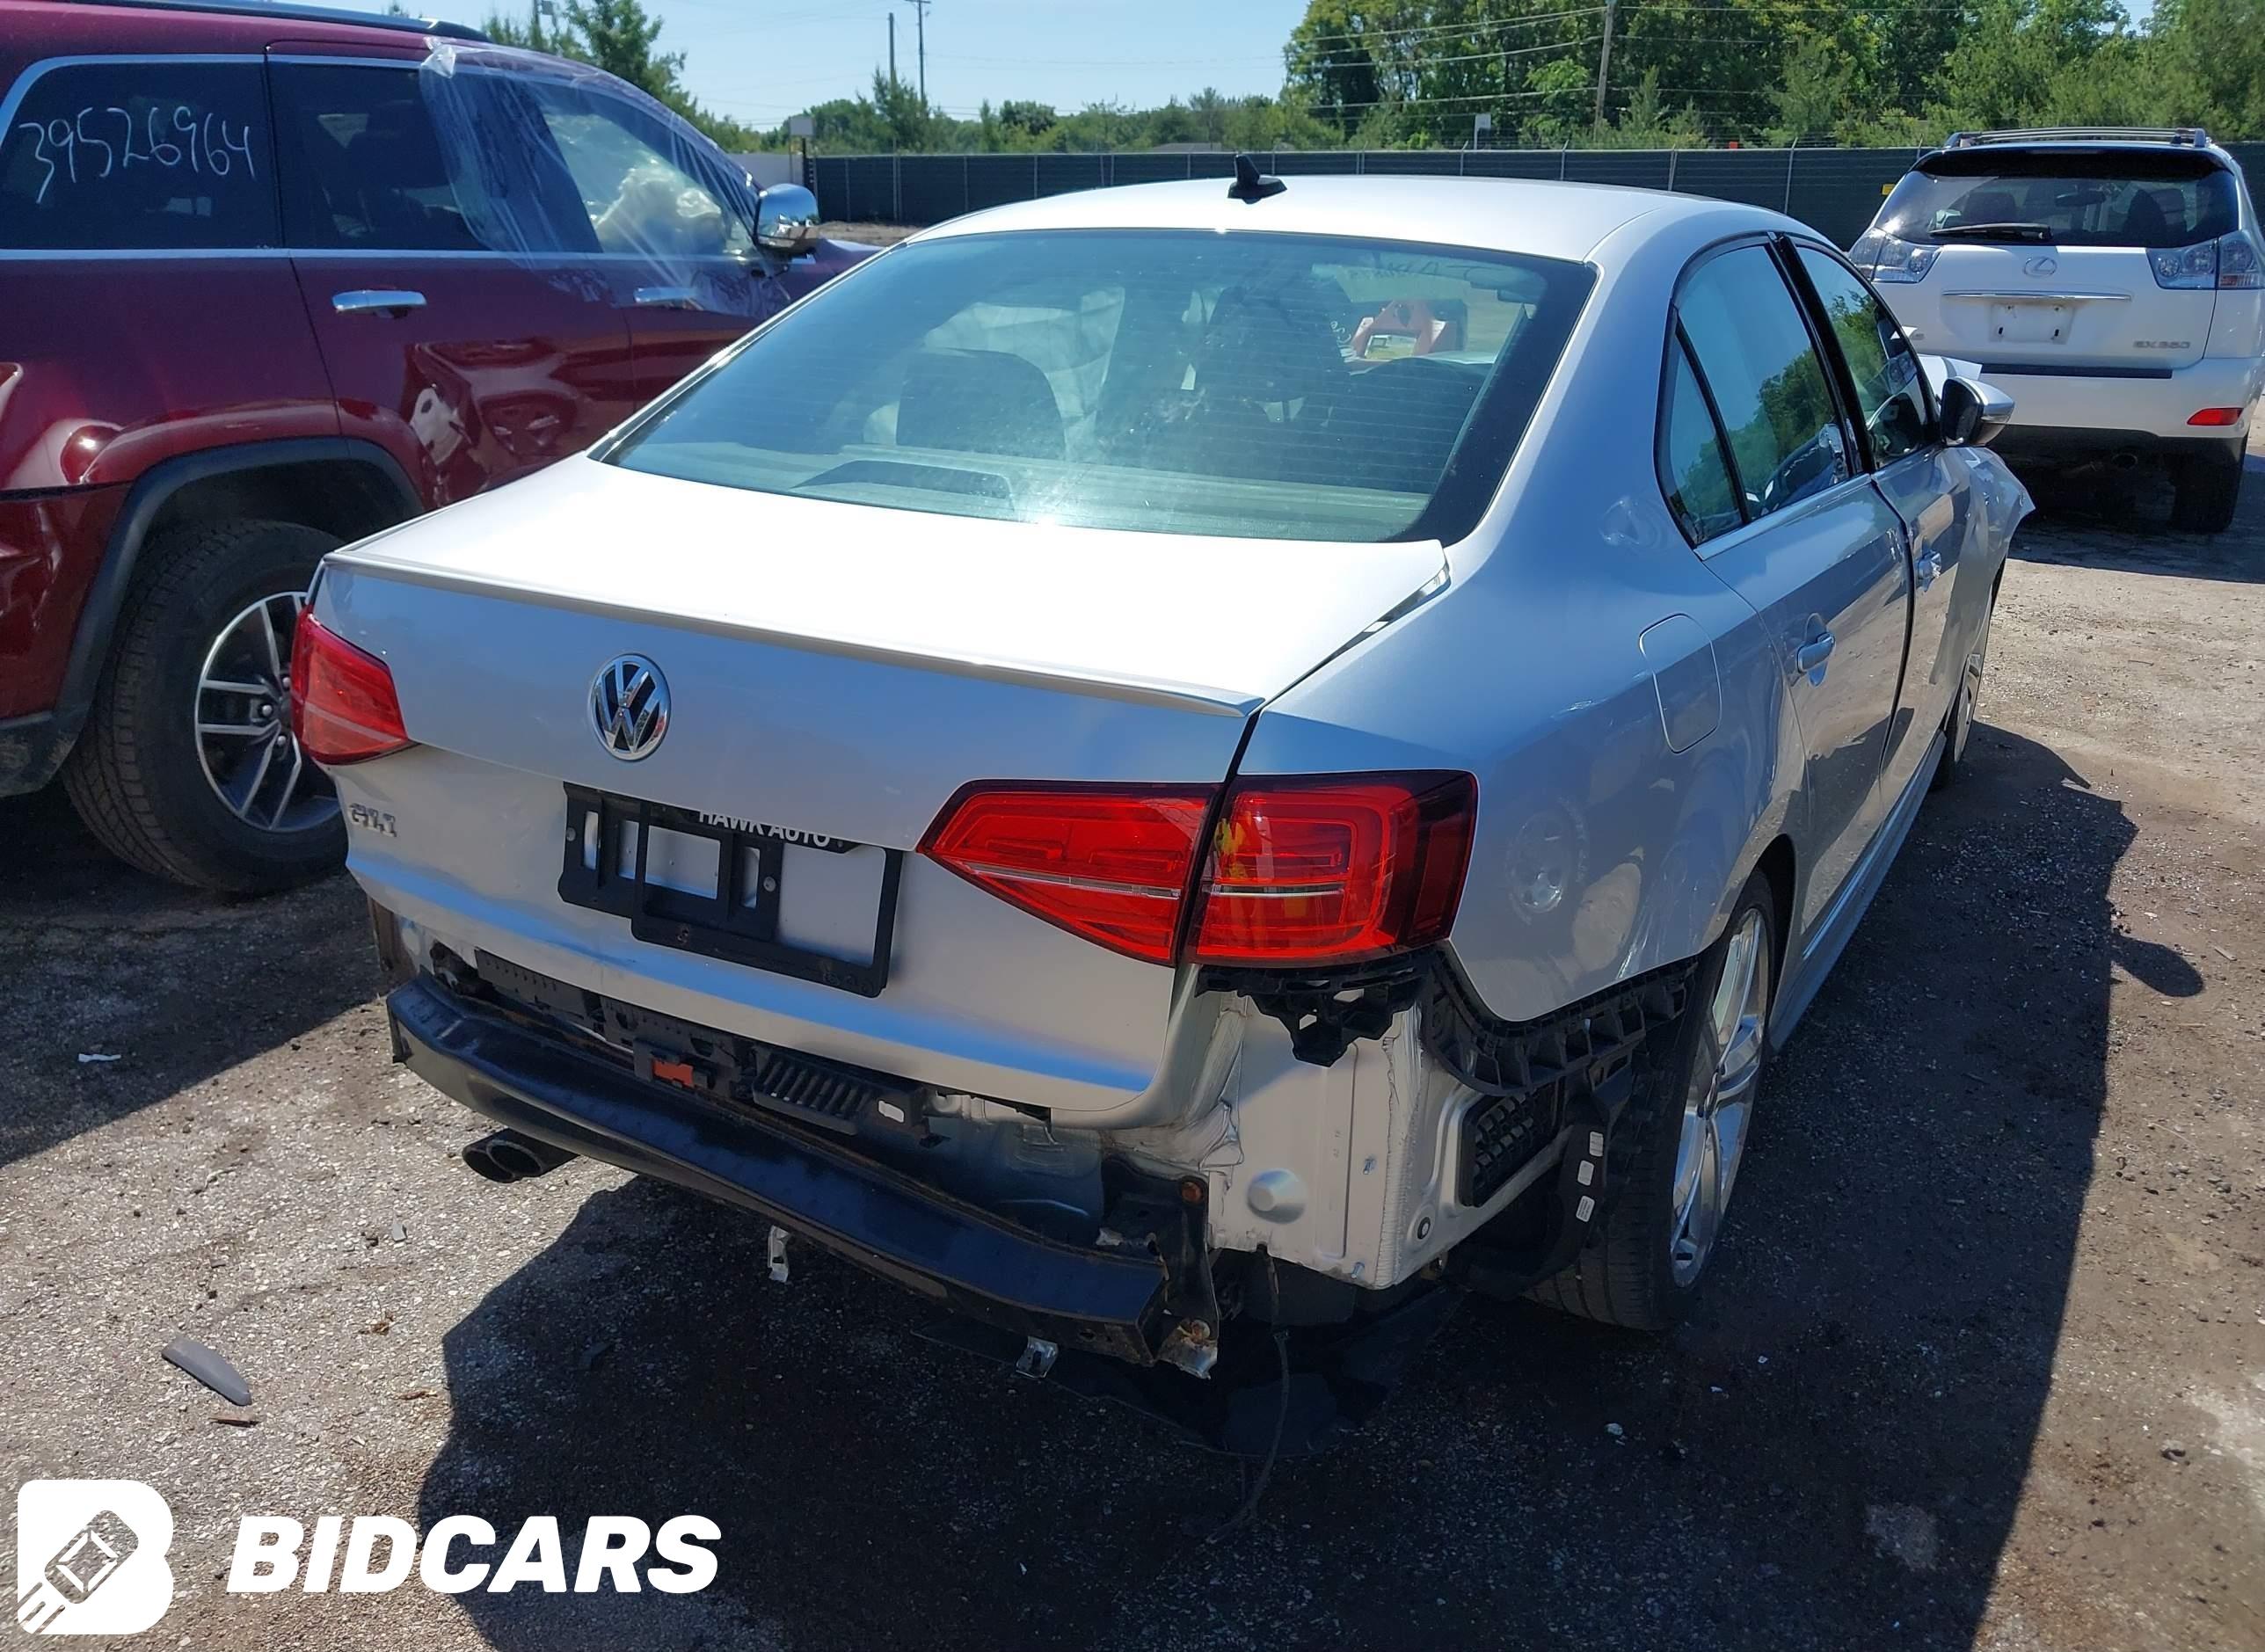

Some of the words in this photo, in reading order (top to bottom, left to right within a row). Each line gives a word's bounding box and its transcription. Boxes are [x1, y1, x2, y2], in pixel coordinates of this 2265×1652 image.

[18, 106, 257, 204] 39526964
[699, 811, 765, 835] HAWK
[768, 826, 831, 848] AUTO
